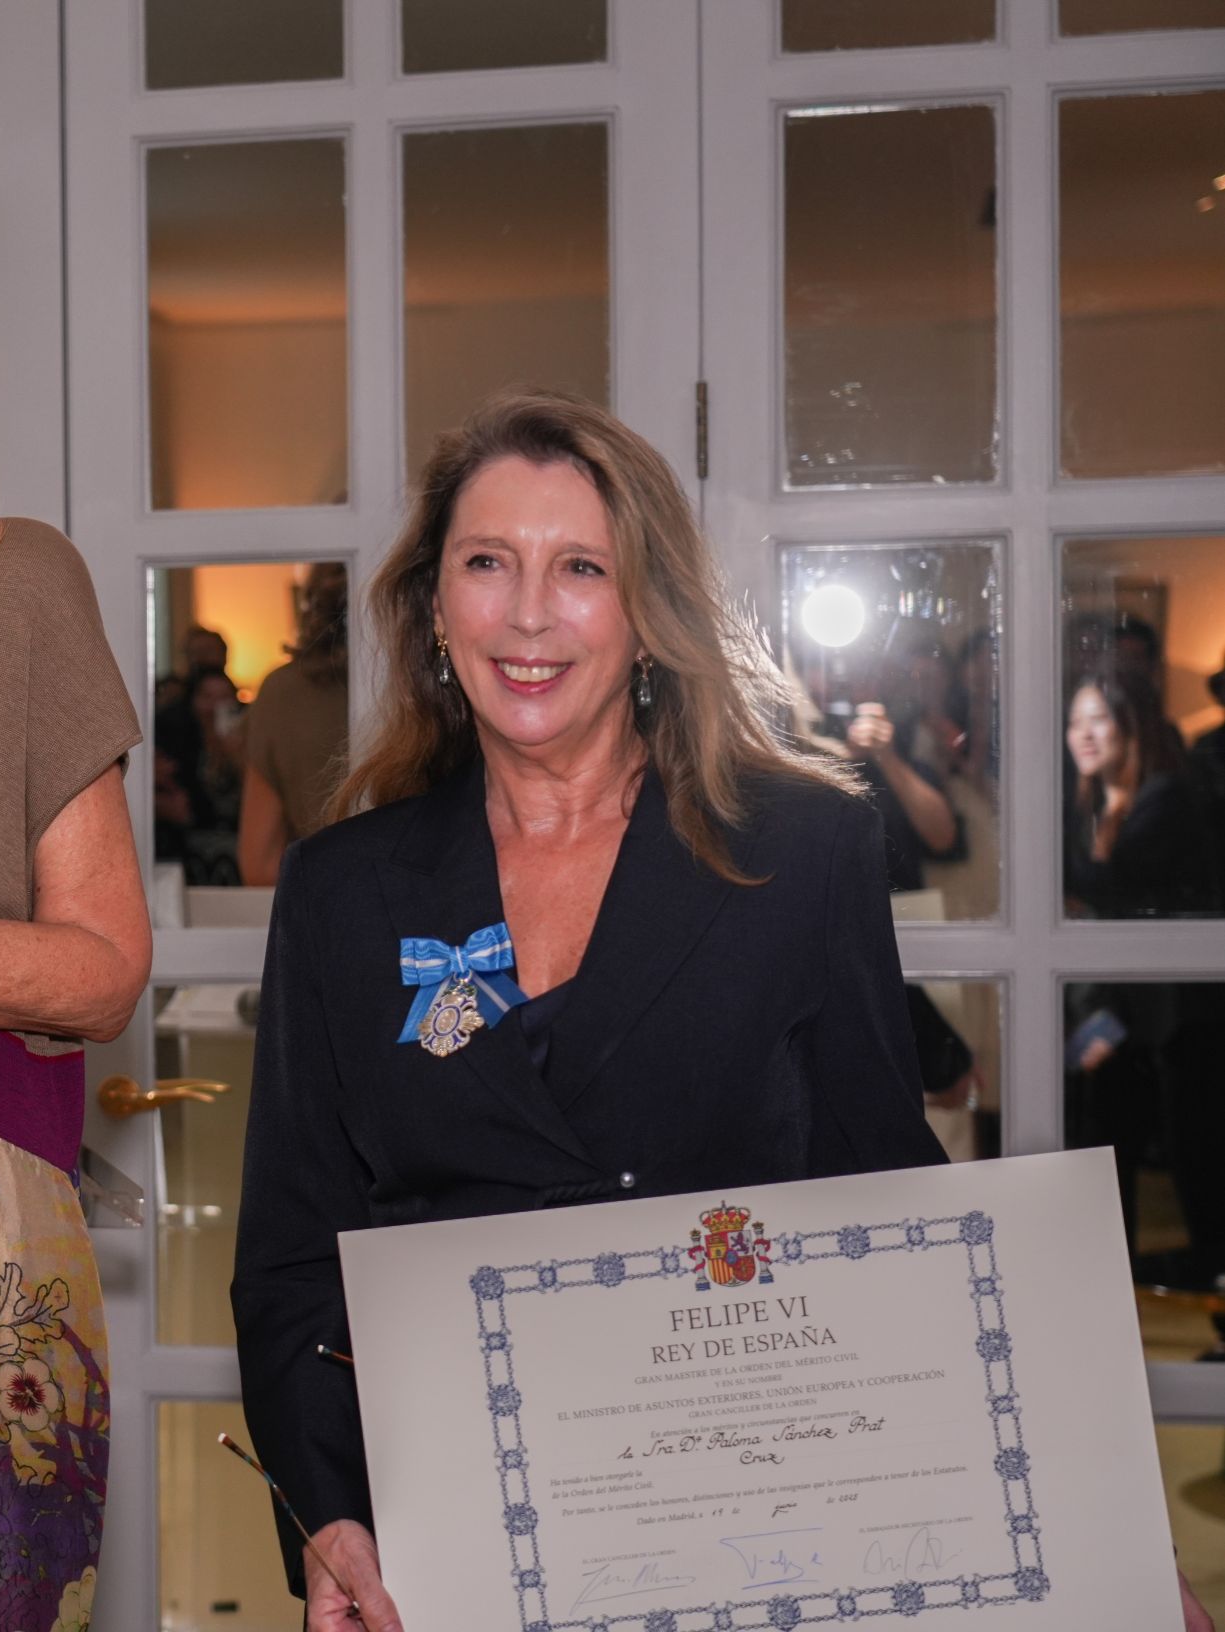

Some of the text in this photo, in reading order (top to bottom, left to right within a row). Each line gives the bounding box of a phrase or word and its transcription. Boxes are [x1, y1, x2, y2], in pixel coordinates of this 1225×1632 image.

[670, 1296, 808, 1331] FELIPE VI
[652, 1326, 837, 1364] REY DE ESPAÑA
[634, 1353, 859, 1384] GRAN MAESTRE DE LA ORDEN DEL MÉRITO CIVIL
[748, 1374, 782, 1383] NOMBRE
[557, 1370, 944, 1421] EL MINISTRO DE ASUNTOS EXTERIORES, UNIÓN EUROPEA Y COOPERACIÓN
[688, 1410, 712, 1418] GRAN
[715, 1405, 761, 1415] CANCILLER
[788, 1398, 817, 1407] ORDEN
[707, 1432, 762, 1450] Paloma
[773, 1424, 837, 1441] Sánchez
[848, 1416, 885, 1433] Prat
[740, 1451, 784, 1464] Cruz
